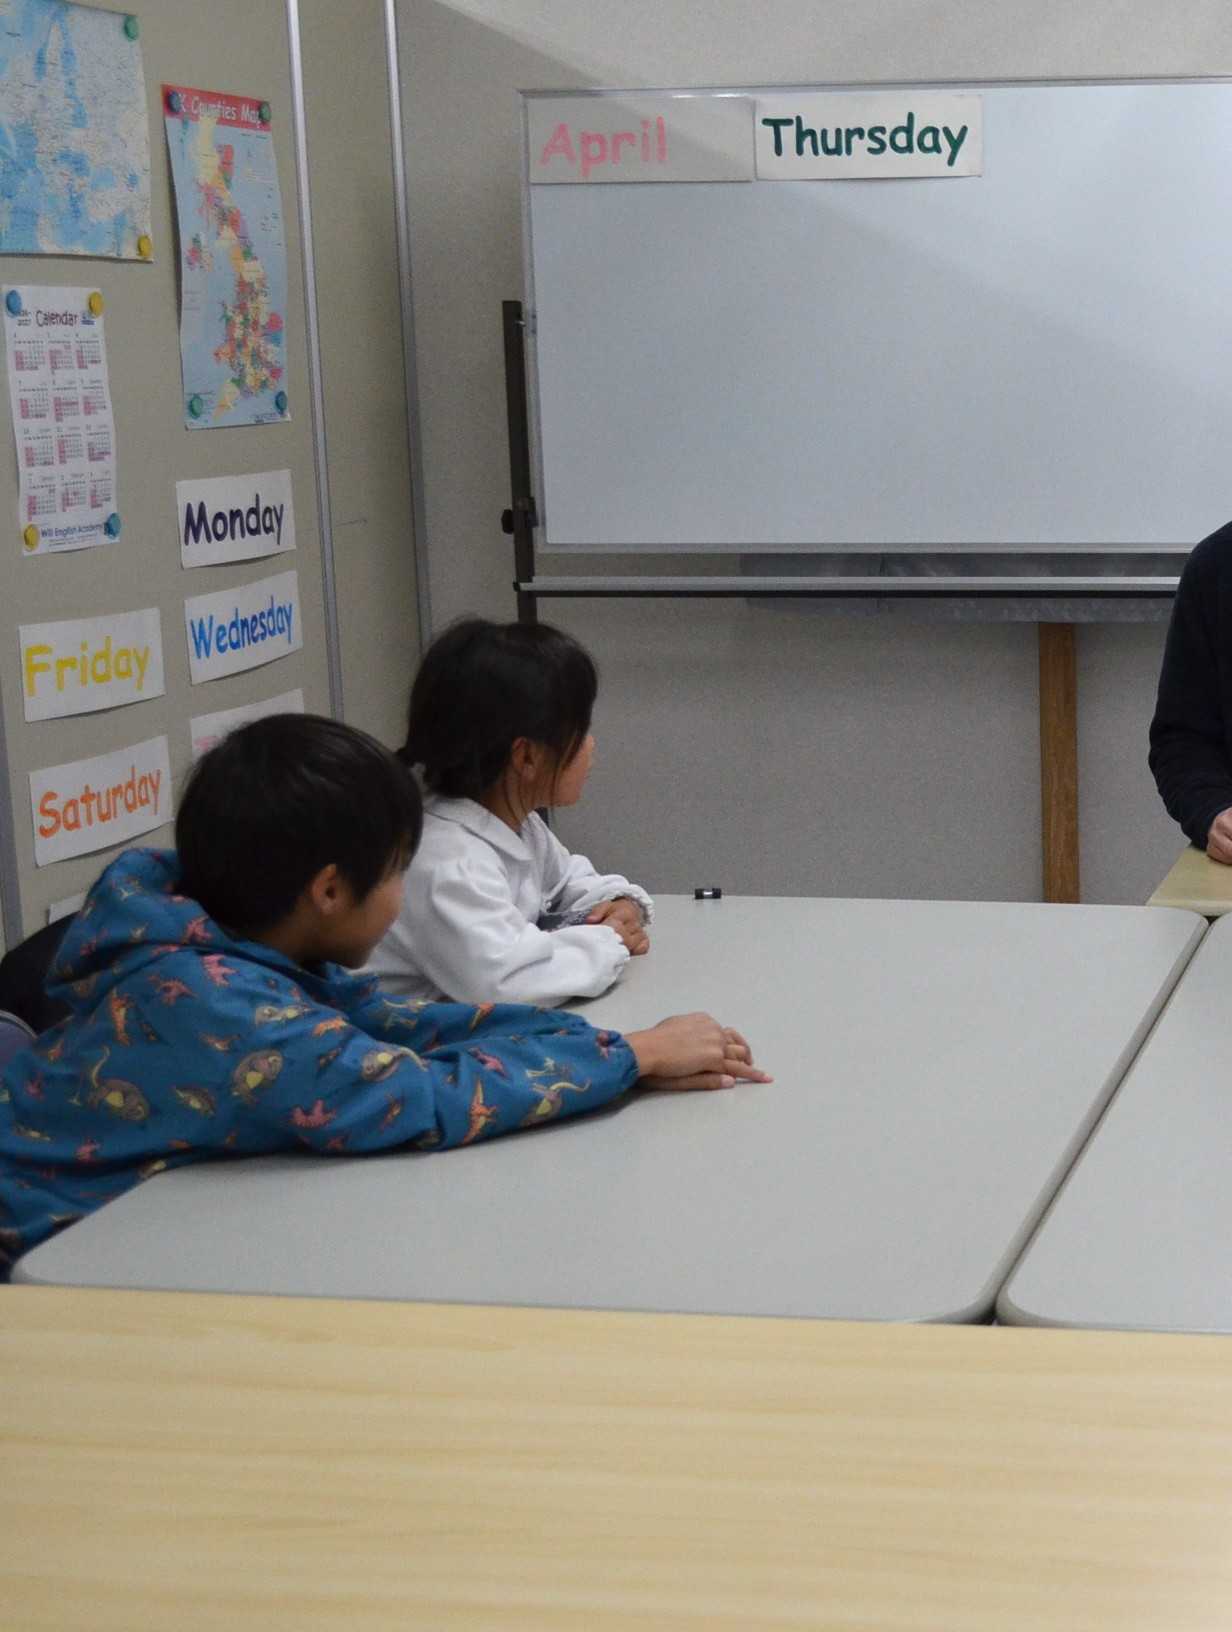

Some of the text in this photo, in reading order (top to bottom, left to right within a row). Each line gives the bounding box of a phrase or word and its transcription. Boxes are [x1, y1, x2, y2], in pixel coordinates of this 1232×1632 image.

[540, 116, 668, 177] April
[761, 111, 969, 167] Thursday
[35, 310, 79, 328] Calendar
[183, 493, 285, 546] Monday
[189, 595, 294, 660] Wednesday
[23, 635, 151, 697] Friday
[37, 764, 162, 839] Saturday
